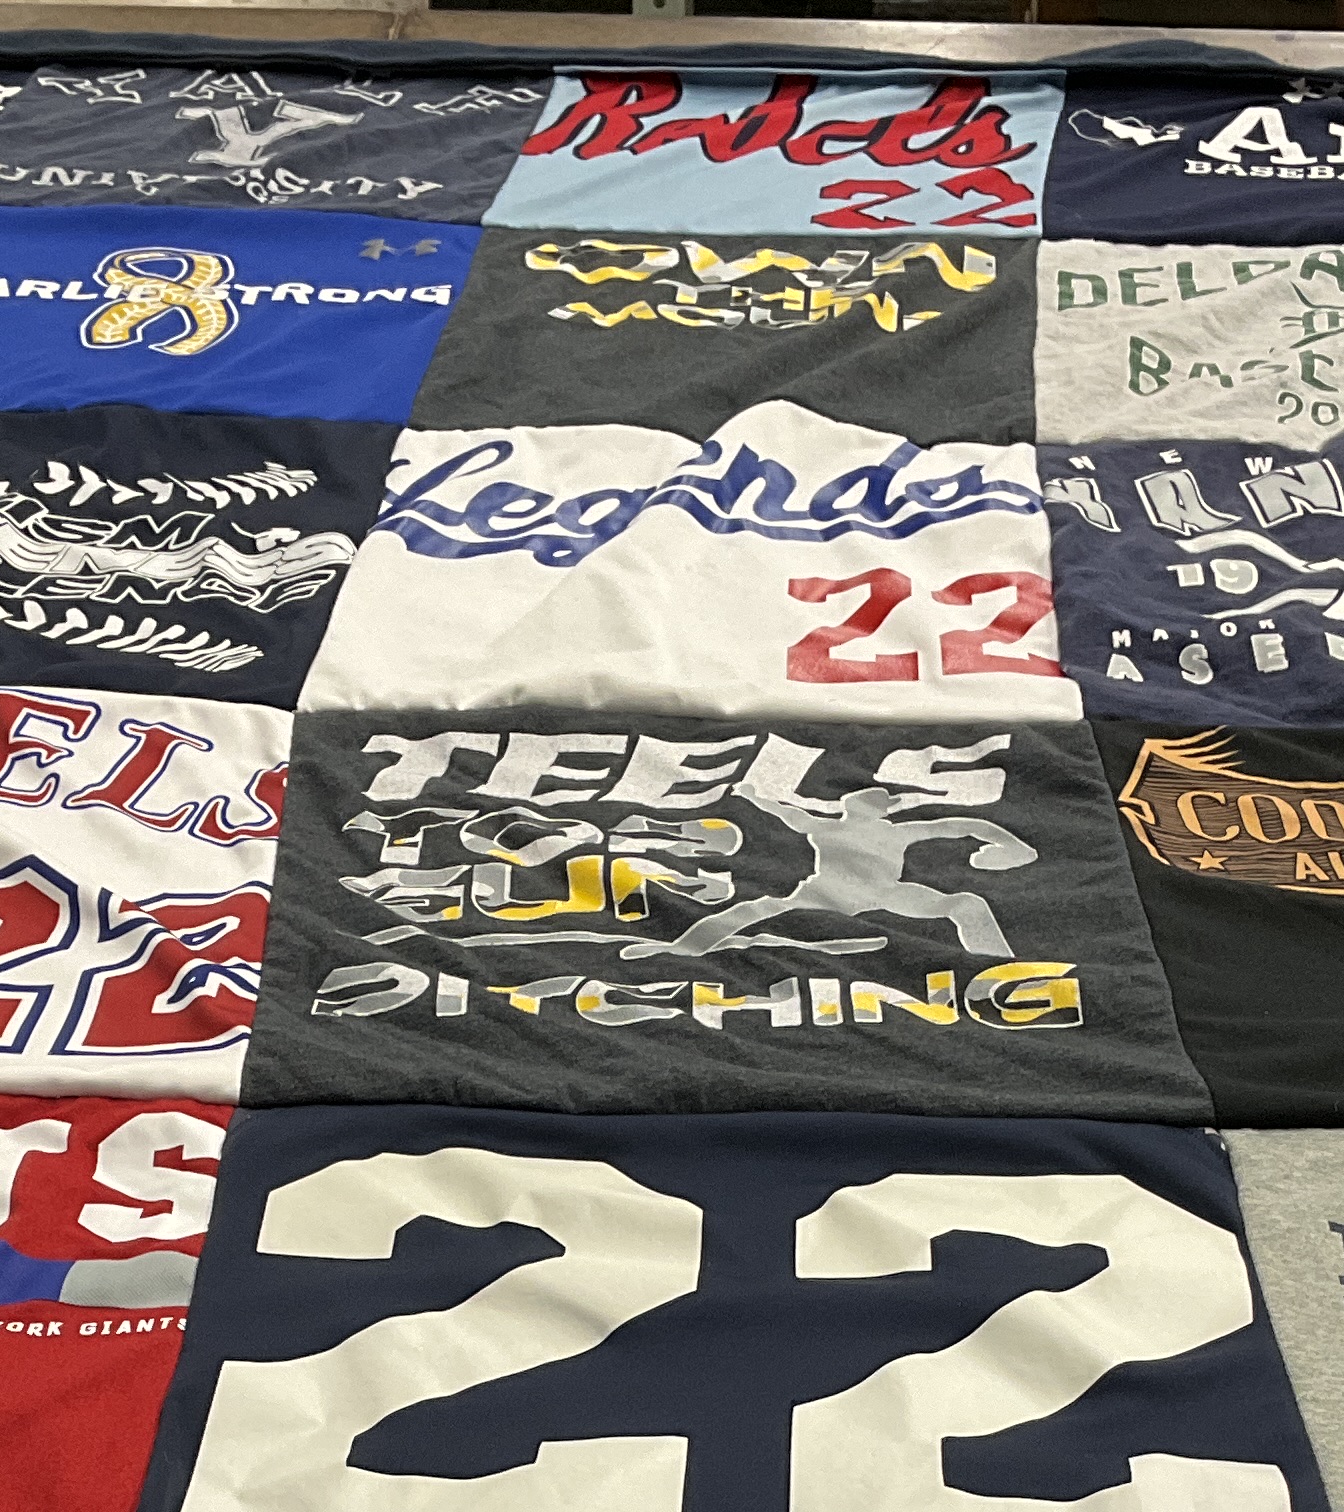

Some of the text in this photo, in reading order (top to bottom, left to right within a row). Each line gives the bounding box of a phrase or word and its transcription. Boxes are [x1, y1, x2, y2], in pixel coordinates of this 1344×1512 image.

[193, 283, 454, 306] STRONG
[1069, 448, 1273, 475] NEW
[786, 566, 1067, 684] 22
[362, 732, 1013, 818] TEELS
[78, 1316, 187, 1337] GIANTS
